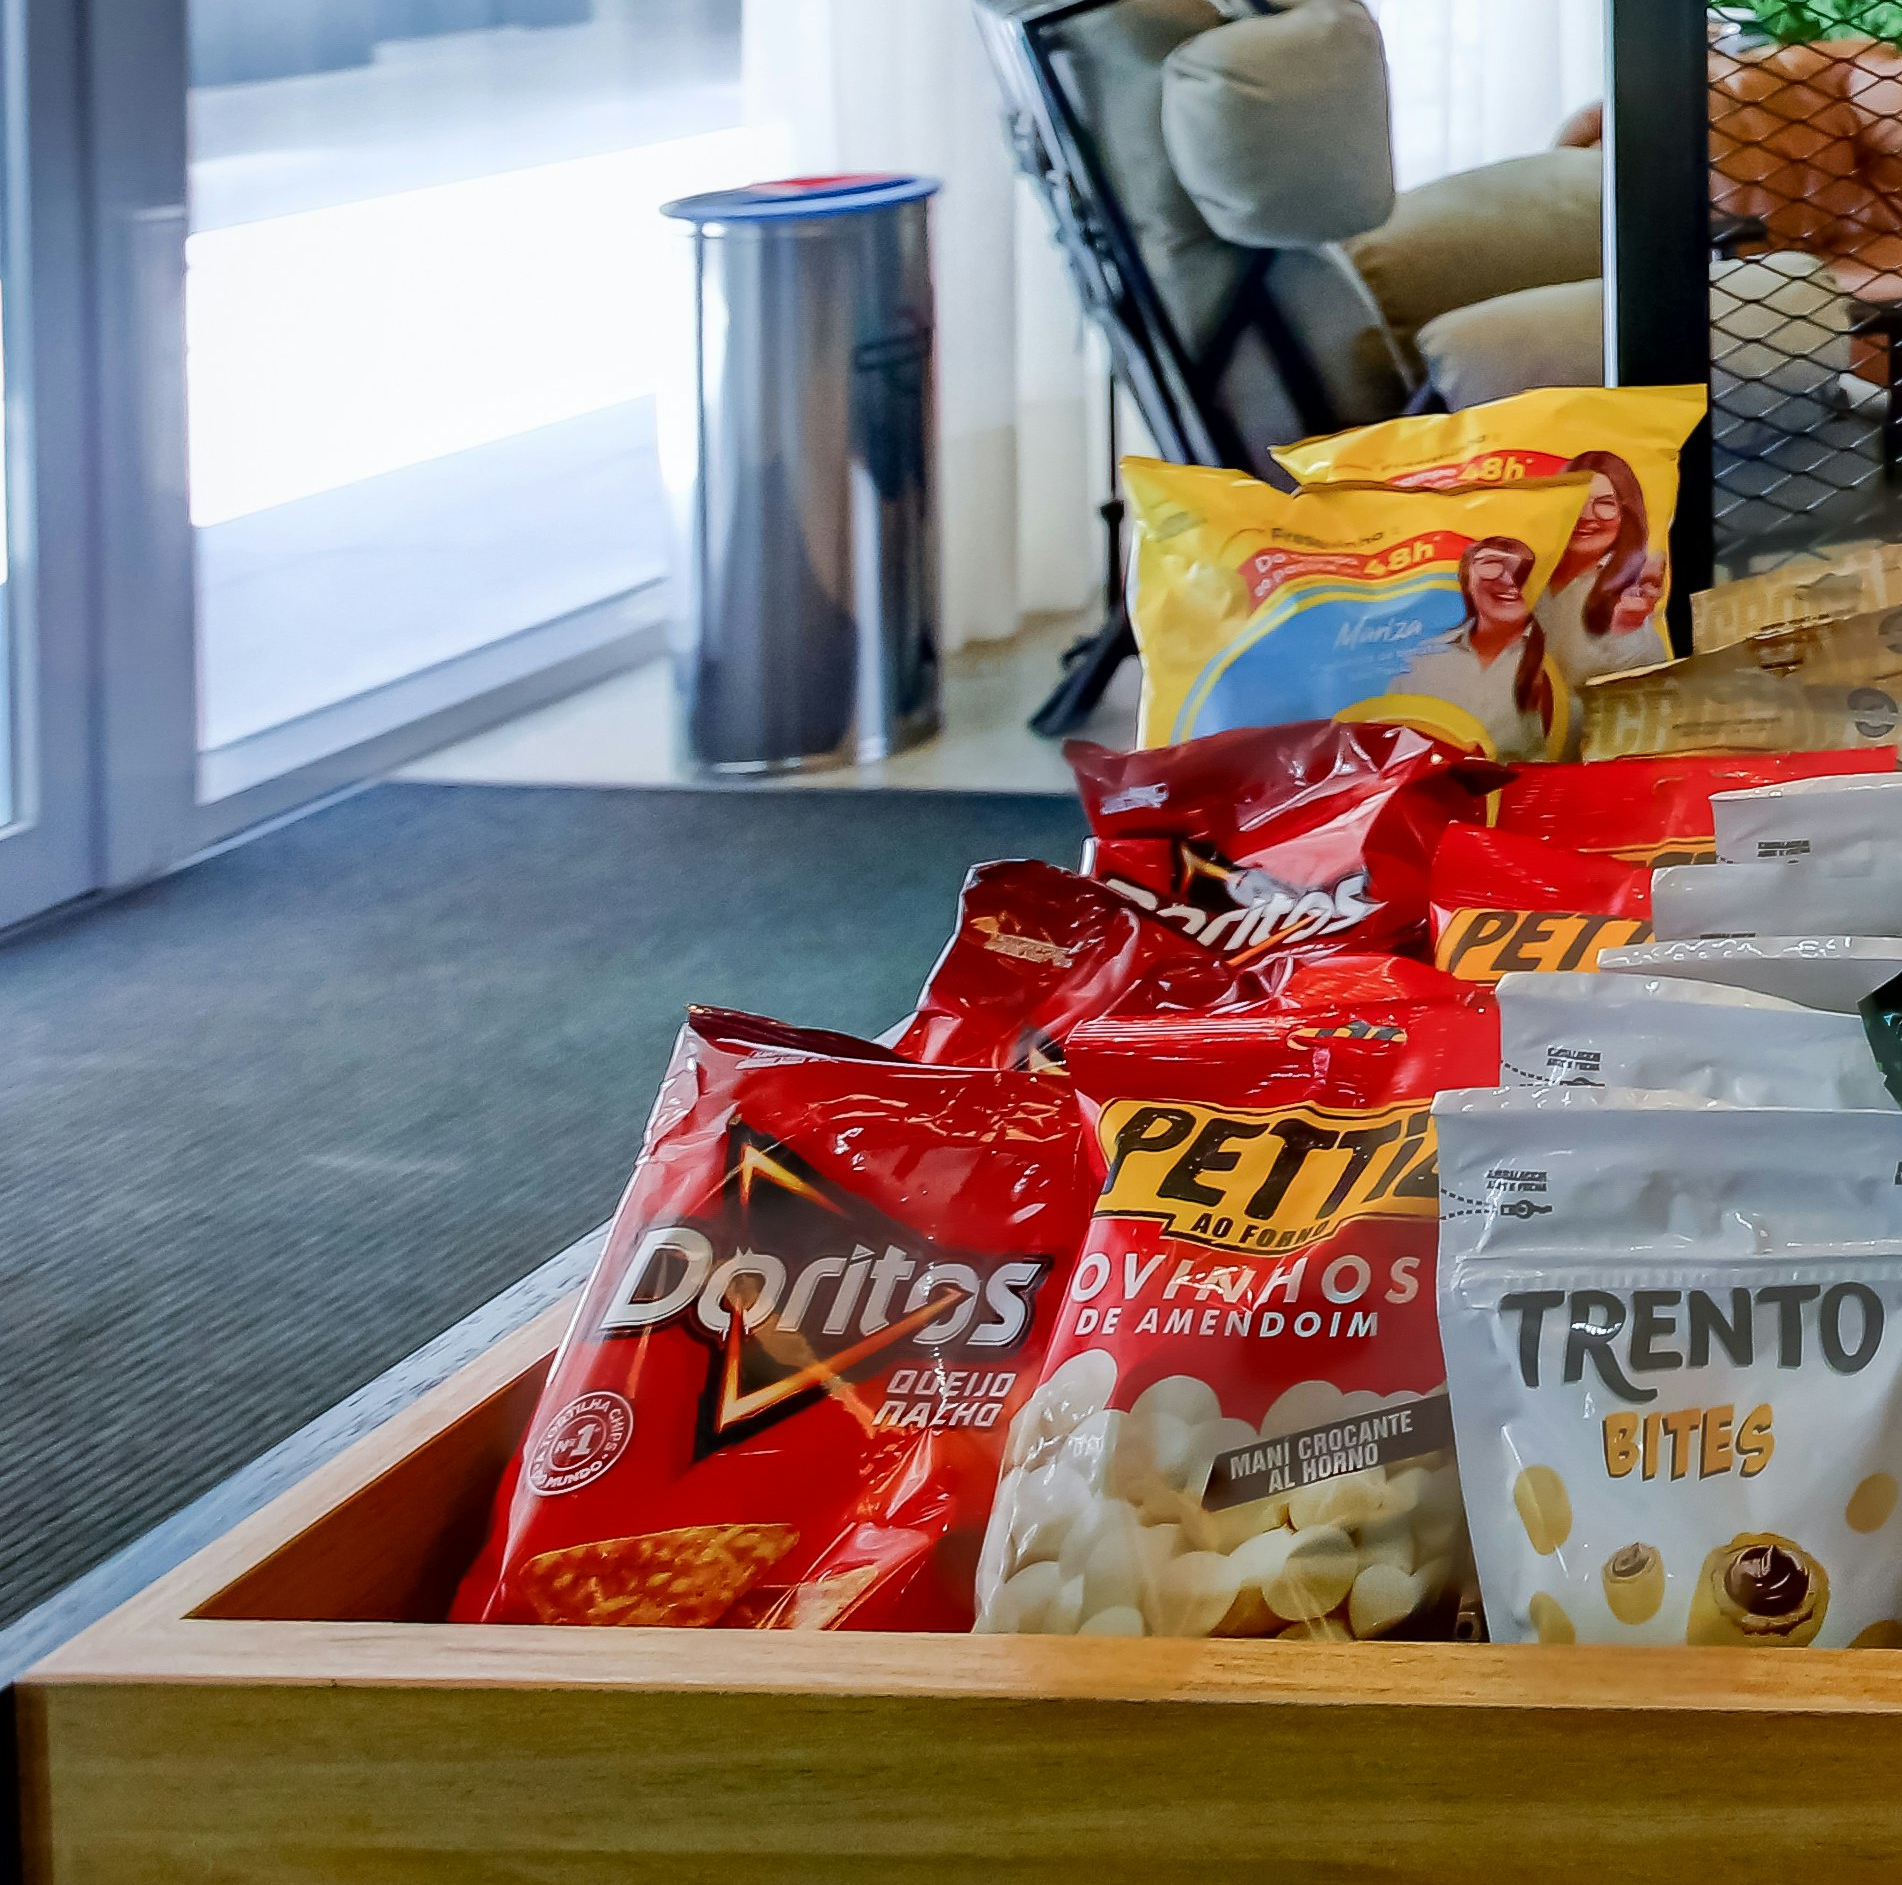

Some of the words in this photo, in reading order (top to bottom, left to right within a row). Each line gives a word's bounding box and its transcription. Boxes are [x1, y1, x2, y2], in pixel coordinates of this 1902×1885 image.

[1190, 1213, 1234, 1238] AO
[1238, 1218, 1330, 1248] FORNO
[600, 1225, 1054, 1349] Doritos
[1070, 1252, 1421, 1306] OVINHOS
[1074, 1306, 1118, 1338] DE
[1133, 1307, 1381, 1340] AMENDOIM
[1498, 1281, 1886, 1404] TRENTO
[886, 1368, 1017, 1403] QUEIJO
[873, 1399, 1003, 1430] NACHO
[1298, 1409, 1414, 1461] CROCANTE
[1268, 1467, 1296, 1494] AL
[1302, 1442, 1379, 1484] HORNO
[1601, 1402, 1776, 1482] BITES
